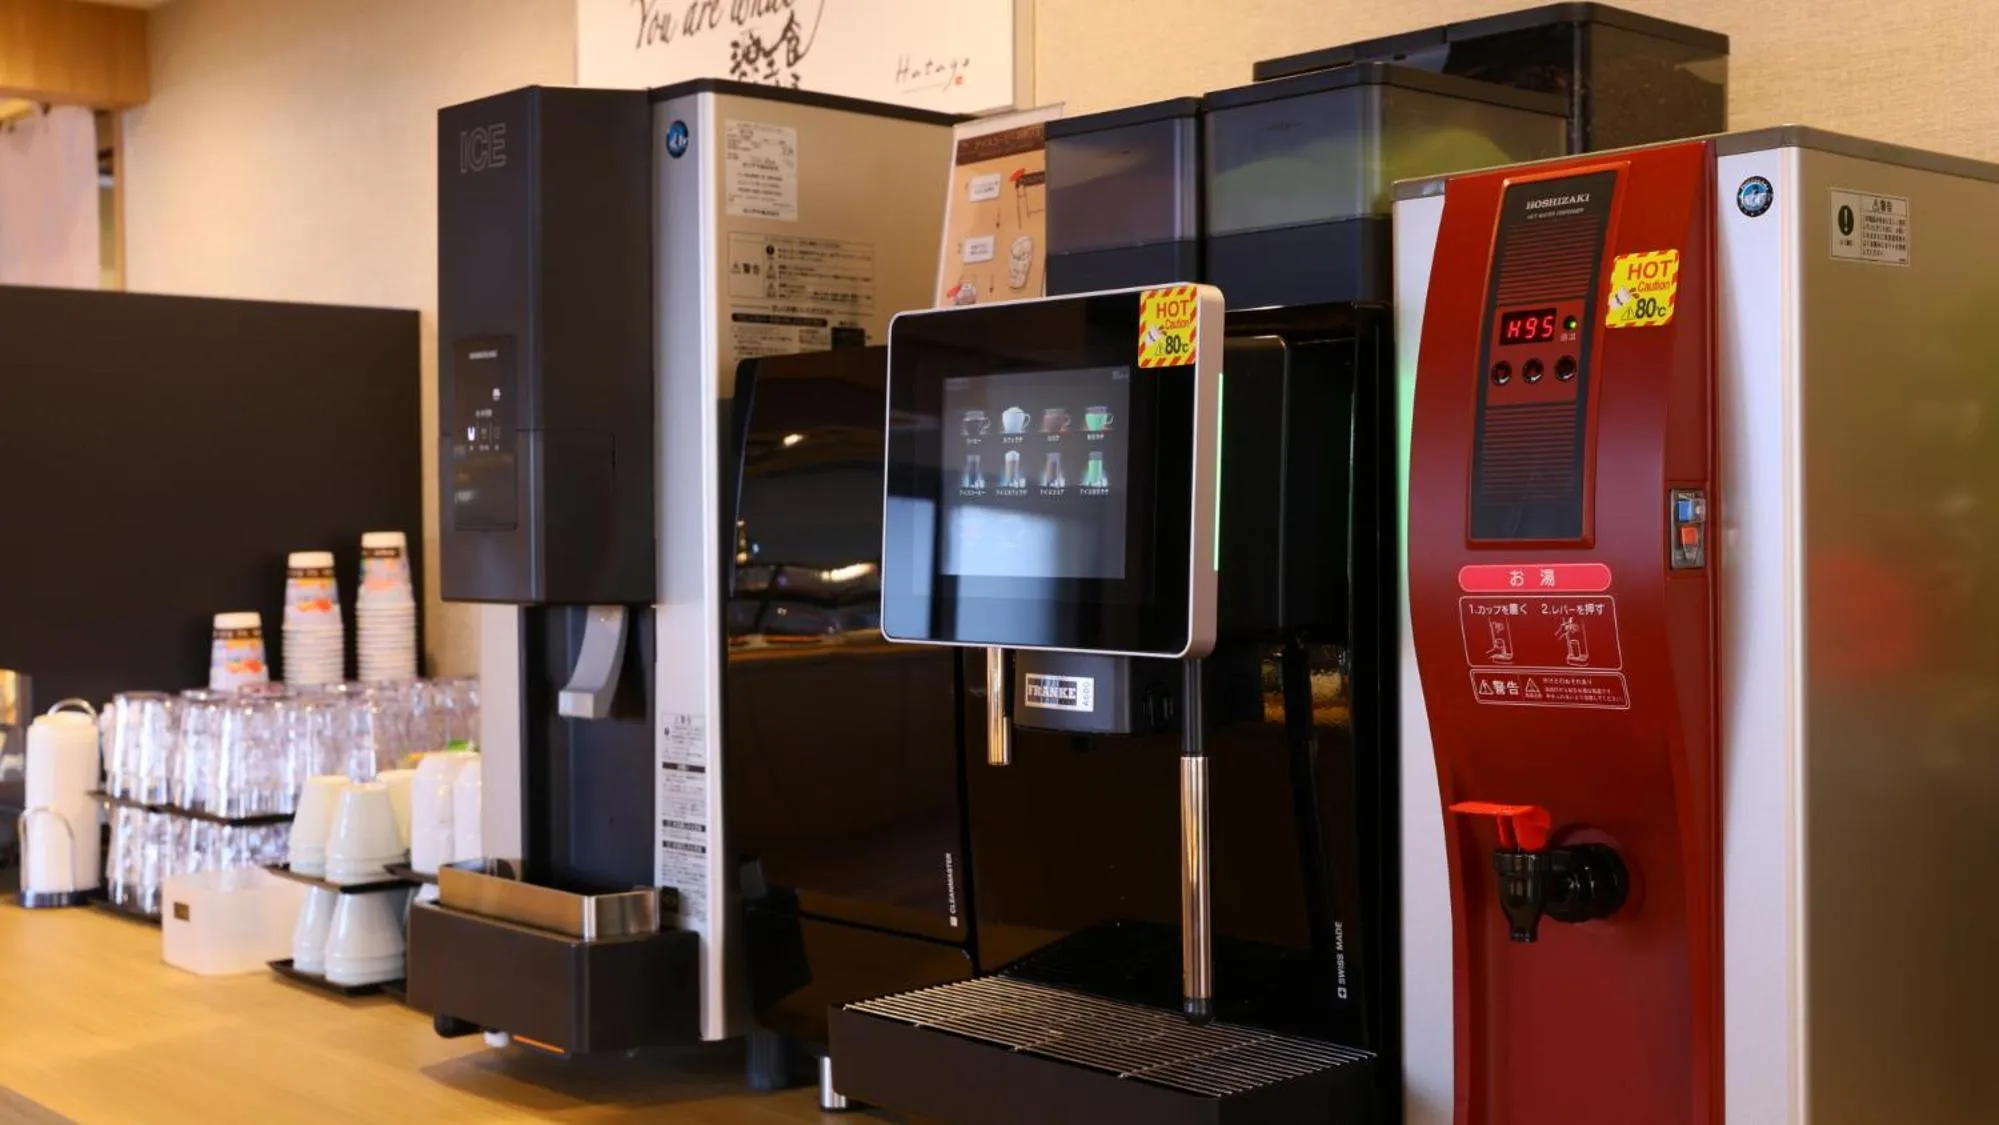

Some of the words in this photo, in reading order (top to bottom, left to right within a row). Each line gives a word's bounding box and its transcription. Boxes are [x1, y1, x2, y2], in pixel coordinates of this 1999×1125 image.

[460, 122, 507, 174] ICE
[1525, 193, 1591, 210] HOSHIZAKI
[1627, 259, 1673, 281] HOT
[1637, 280, 1671, 292] Caution
[1156, 300, 1190, 319] HOT
[1027, 683, 1077, 700] FRANKE
[1492, 680, 1520, 696] 警告
[945, 852, 957, 914] CLEANMASTER
[1334, 920, 1344, 951] MADE
[1336, 953, 1346, 985] SWISS
